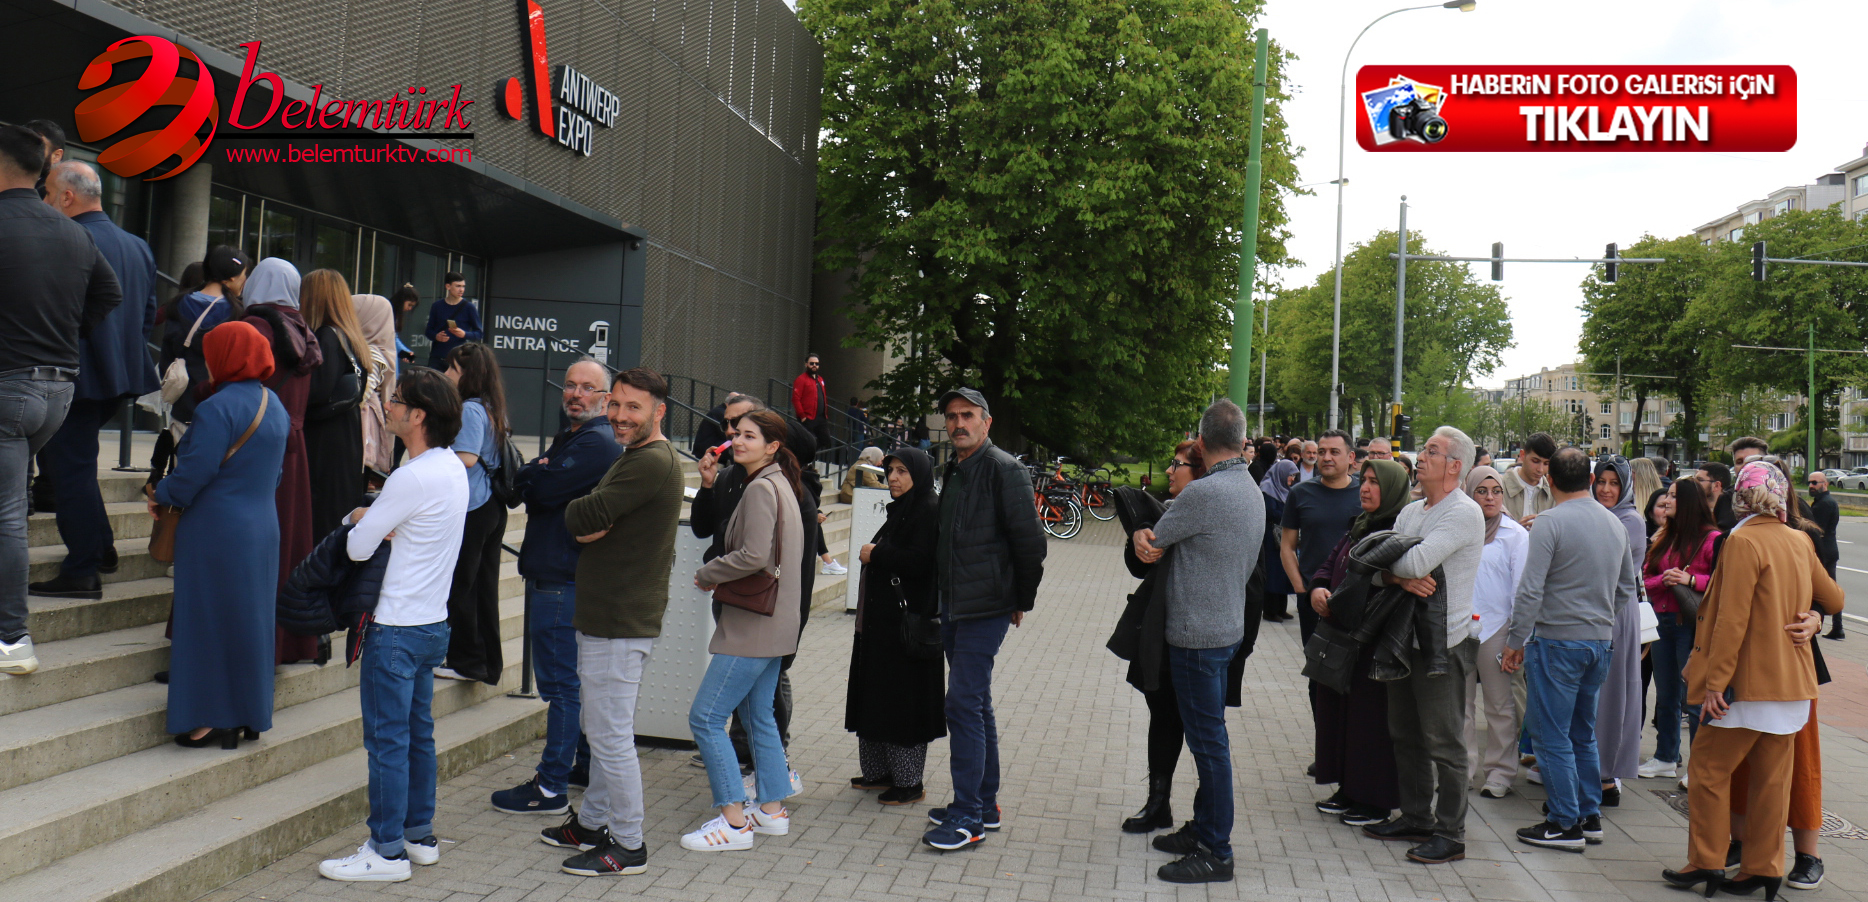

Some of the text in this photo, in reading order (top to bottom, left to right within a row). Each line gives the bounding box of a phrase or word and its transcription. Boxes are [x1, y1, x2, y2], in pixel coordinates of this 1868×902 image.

[560, 64, 620, 129] ANTWERP
[558, 105, 593, 157] EXPO
[494, 315, 558, 332] INGANG
